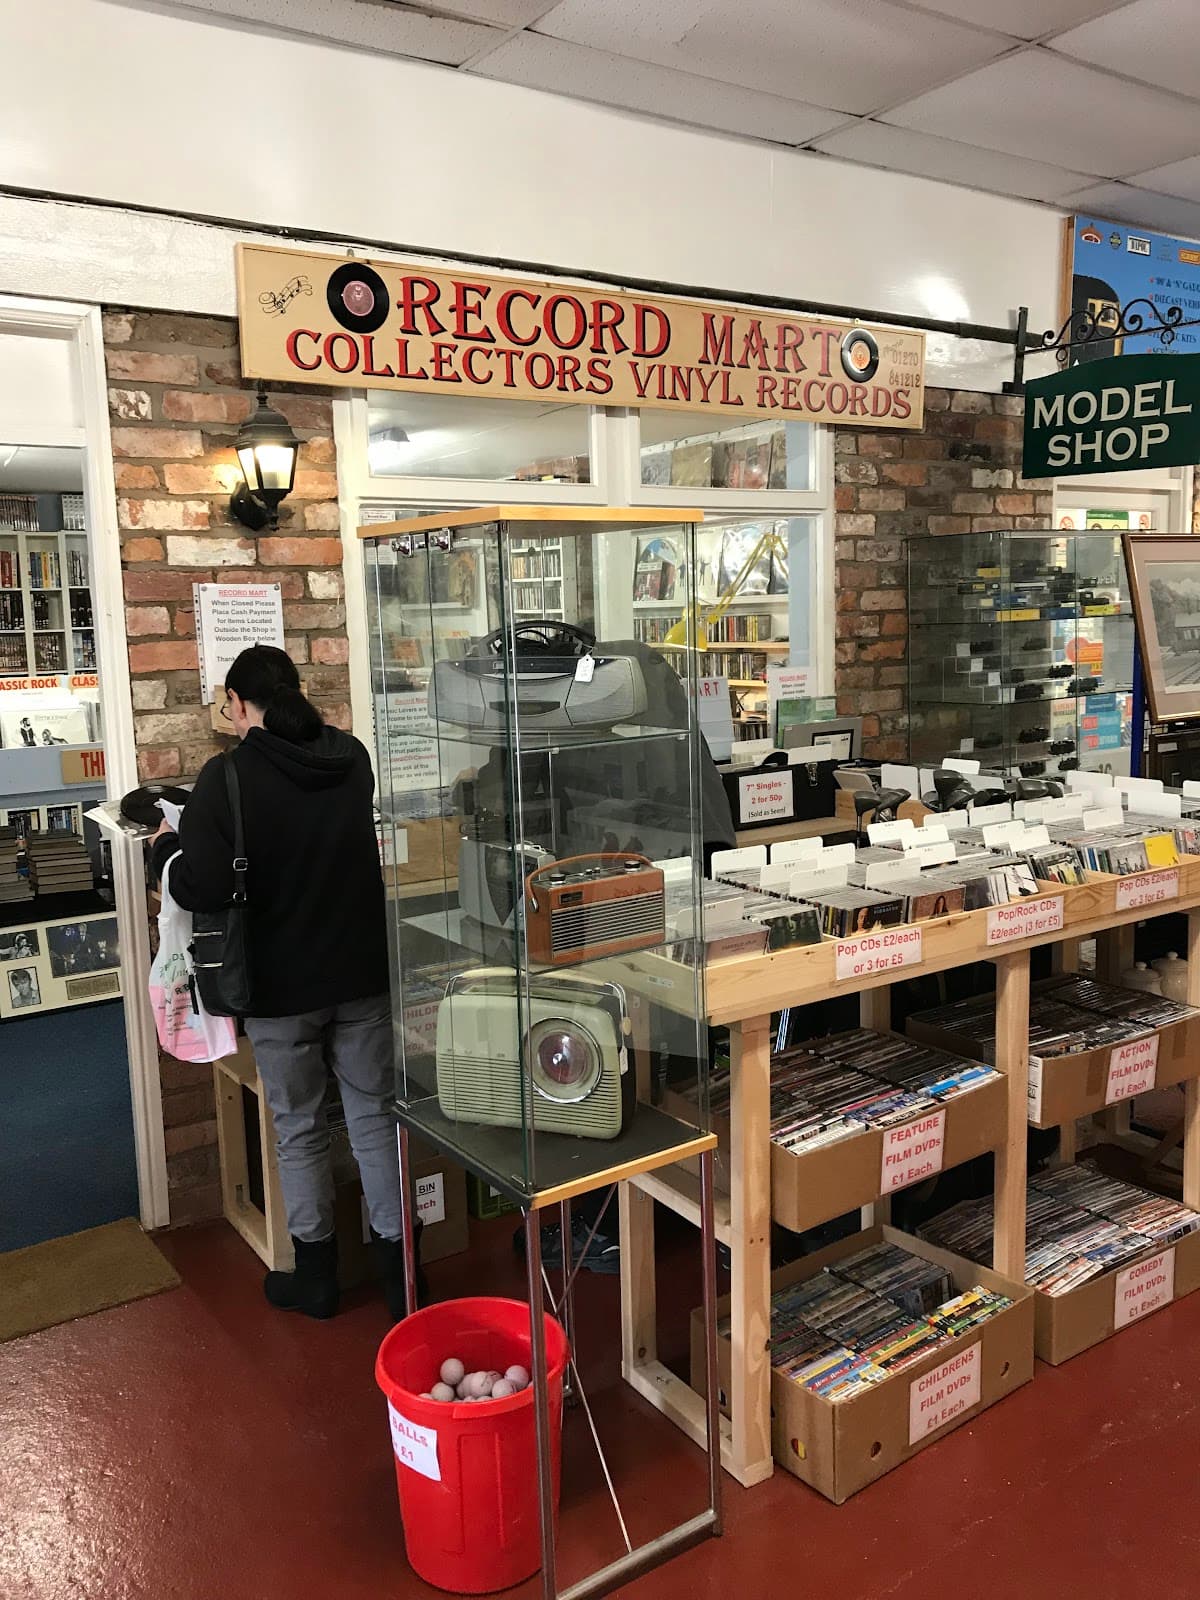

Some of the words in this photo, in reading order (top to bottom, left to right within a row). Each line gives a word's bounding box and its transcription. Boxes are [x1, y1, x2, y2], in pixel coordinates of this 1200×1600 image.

[396, 276, 671, 358] RECORD
[698, 312, 842, 377] MART
[286, 329, 613, 394] COLLECTORS
[628, 361, 743, 406] VINYL
[756, 376, 912, 419] RECORDS
[1032, 379, 1192, 429] MODEL
[1047, 422, 1169, 467] SHOP
[31, 679, 57, 689] ROCK
[756, 781, 781, 791] Singles
[1120, 882, 1133, 891] Pop
[1135, 878, 1150, 887] CDs
[1144, 893, 1154, 902] for
[1156, 890, 1165, 899] £5
[998, 904, 1037, 921] Pop/Rock
[1040, 900, 1056, 912] CDs
[991, 924, 1023, 939] £2/each
[1025, 921, 1033, 934] (3
[1035, 919, 1046, 929] for
[1048, 914, 1060, 927] £5)
[837, 944, 857, 957] Pop
[860, 938, 880, 951] CDs
[883, 930, 920, 947] £2/each
[853, 963, 864, 973] or
[867, 959, 873, 970] 3
[875, 957, 889, 968] for
[891, 953, 903, 965] £5
[1120, 1042, 1151, 1060] ACTION
[1111, 1066, 1131, 1080] FILM
[1133, 1059, 1153, 1072] DVDs
[1115, 1088, 1124, 1097] £1
[1127, 1079, 1146, 1093] Each
[890, 1117, 939, 1144] FEATURE
[886, 1148, 911, 1166] FILM
[915, 1138, 940, 1155] DVDs
[892, 1173, 904, 1185] £1
[908, 1161, 932, 1179] Each
[419, 1182, 435, 1193] BIN
[417, 1200, 436, 1210] ach
[1129, 1257, 1163, 1280] COMEDY
[1124, 1284, 1143, 1301] FILM
[1146, 1275, 1166, 1290] DVDs
[1129, 1307, 1138, 1317] £1
[1141, 1295, 1160, 1311] Each
[918, 1350, 974, 1392] CHILDRENS
[920, 1389, 944, 1411] FILM
[947, 1374, 971, 1395] DVDs
[928, 1414, 938, 1429] £1
[941, 1399, 965, 1418] Each
[401, 1446, 414, 1461] £1
